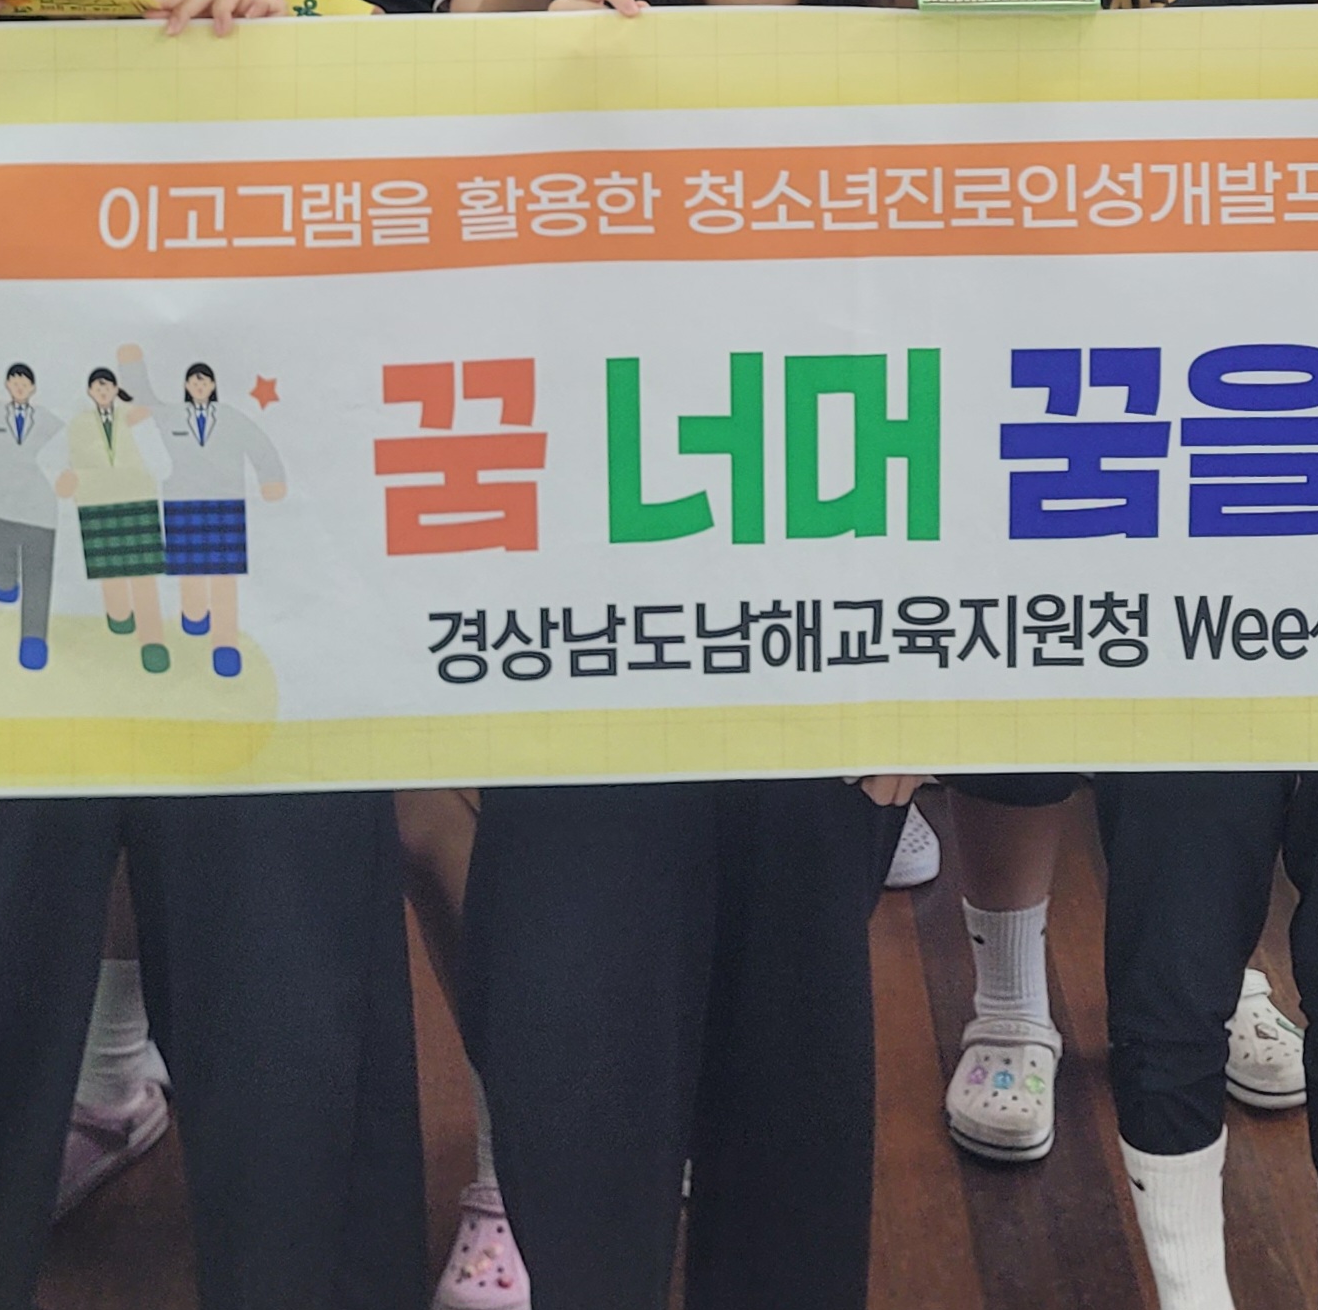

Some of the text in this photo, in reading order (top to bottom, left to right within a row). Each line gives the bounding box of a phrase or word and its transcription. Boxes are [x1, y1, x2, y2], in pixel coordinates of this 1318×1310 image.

[99, 179, 434, 253] 이고그램을
[457, 171, 660, 241] 활용한
[374, 357, 548, 556] 꿈
[605, 347, 941, 545] 너머
[427, 591, 1150, 684] 경상남도남해교육지원청
